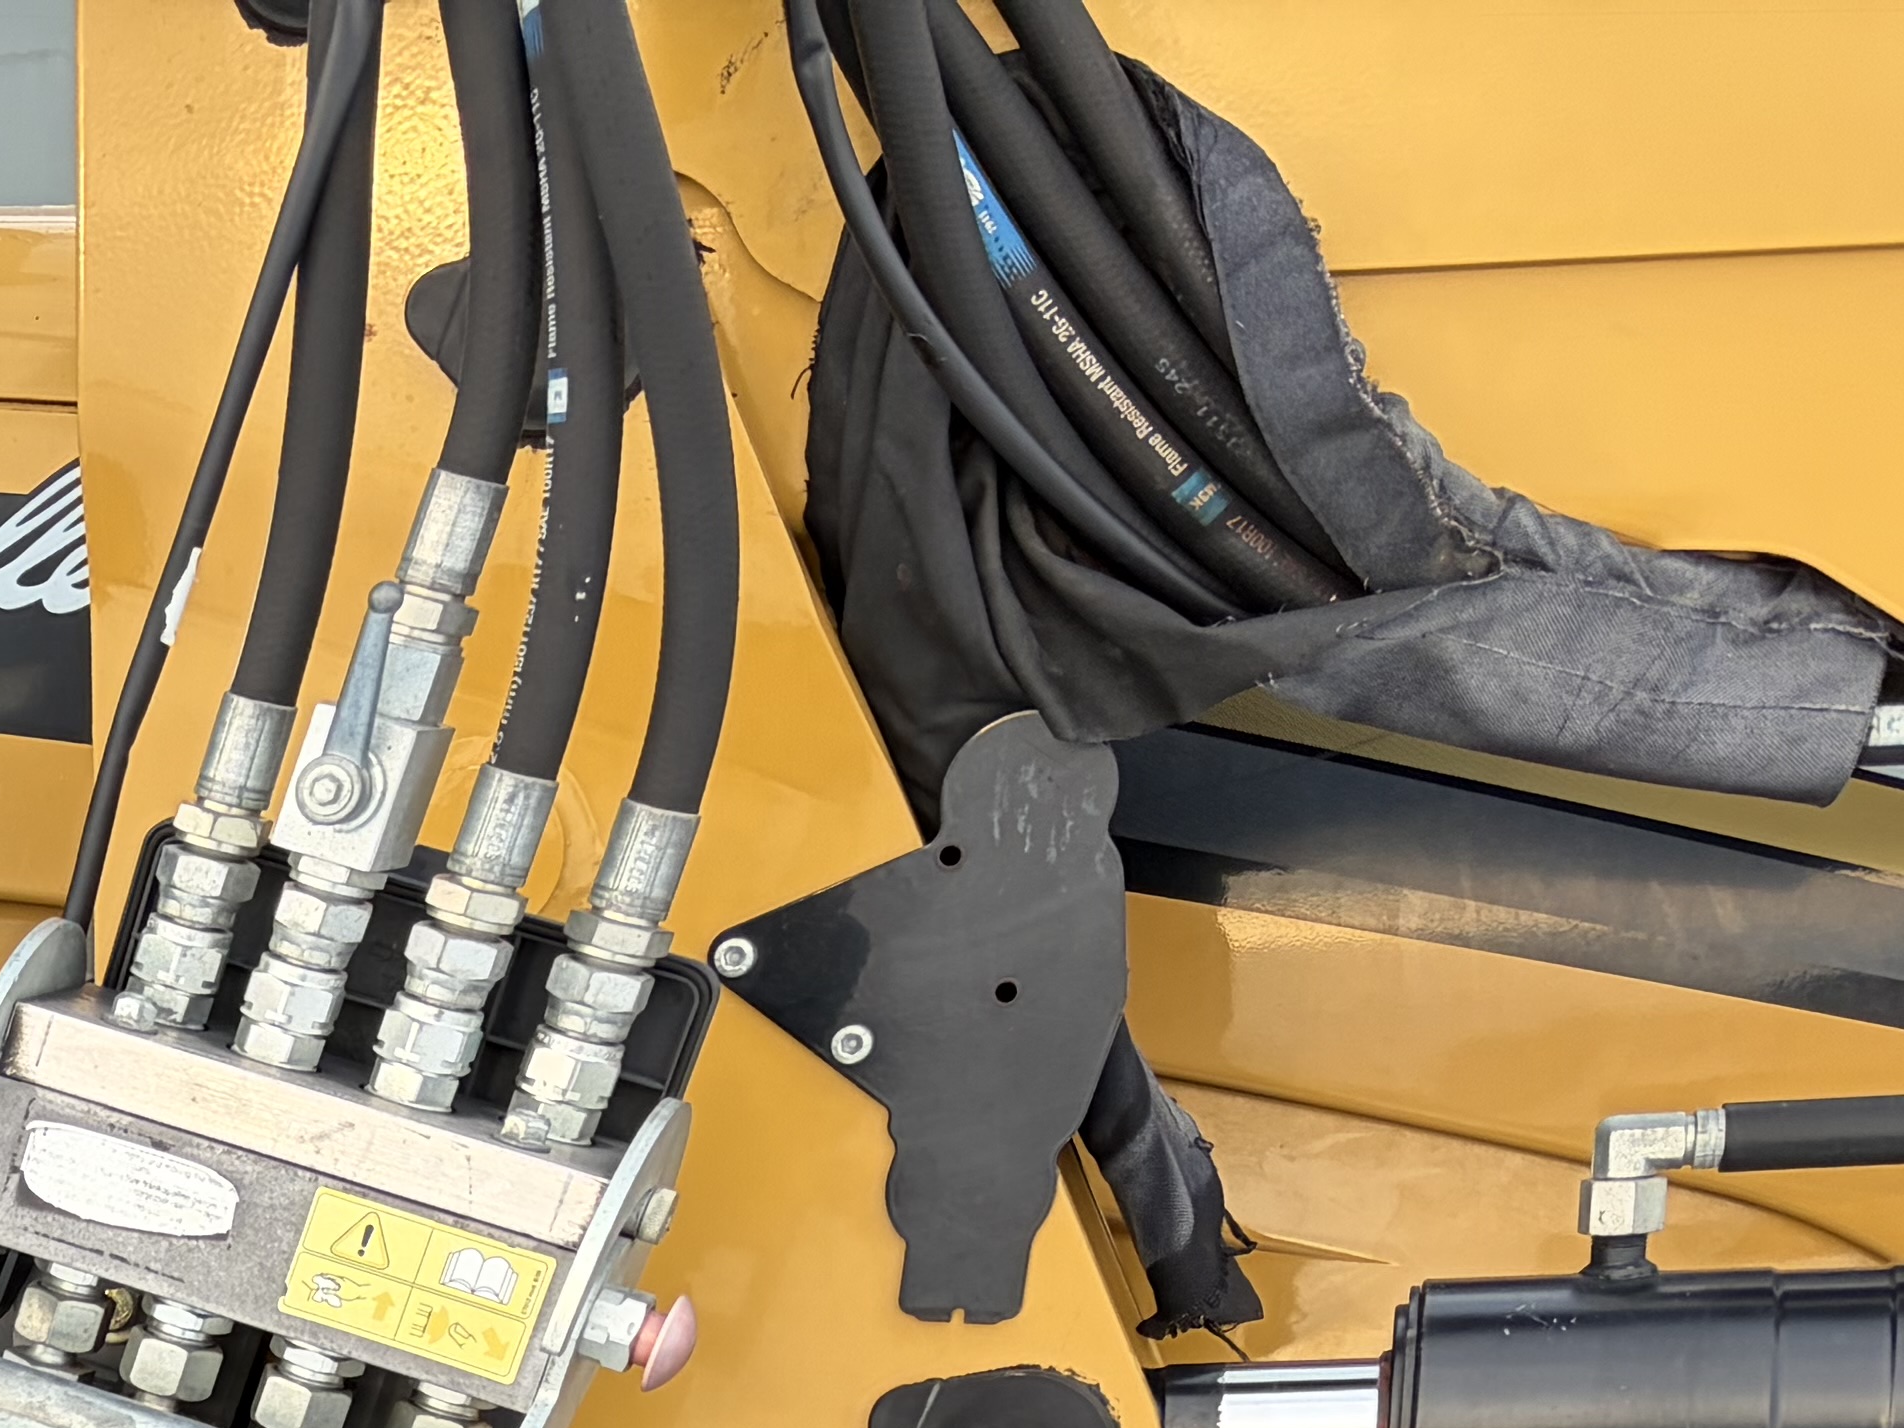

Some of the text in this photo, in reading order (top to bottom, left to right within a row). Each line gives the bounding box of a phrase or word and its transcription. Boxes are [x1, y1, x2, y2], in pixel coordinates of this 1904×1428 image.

[1031, 290, 1076, 342] 2G-11C
[1066, 336, 1106, 384] MSHA
[1096, 374, 1154, 441] Resistant
[1148, 433, 1189, 477] Flame
